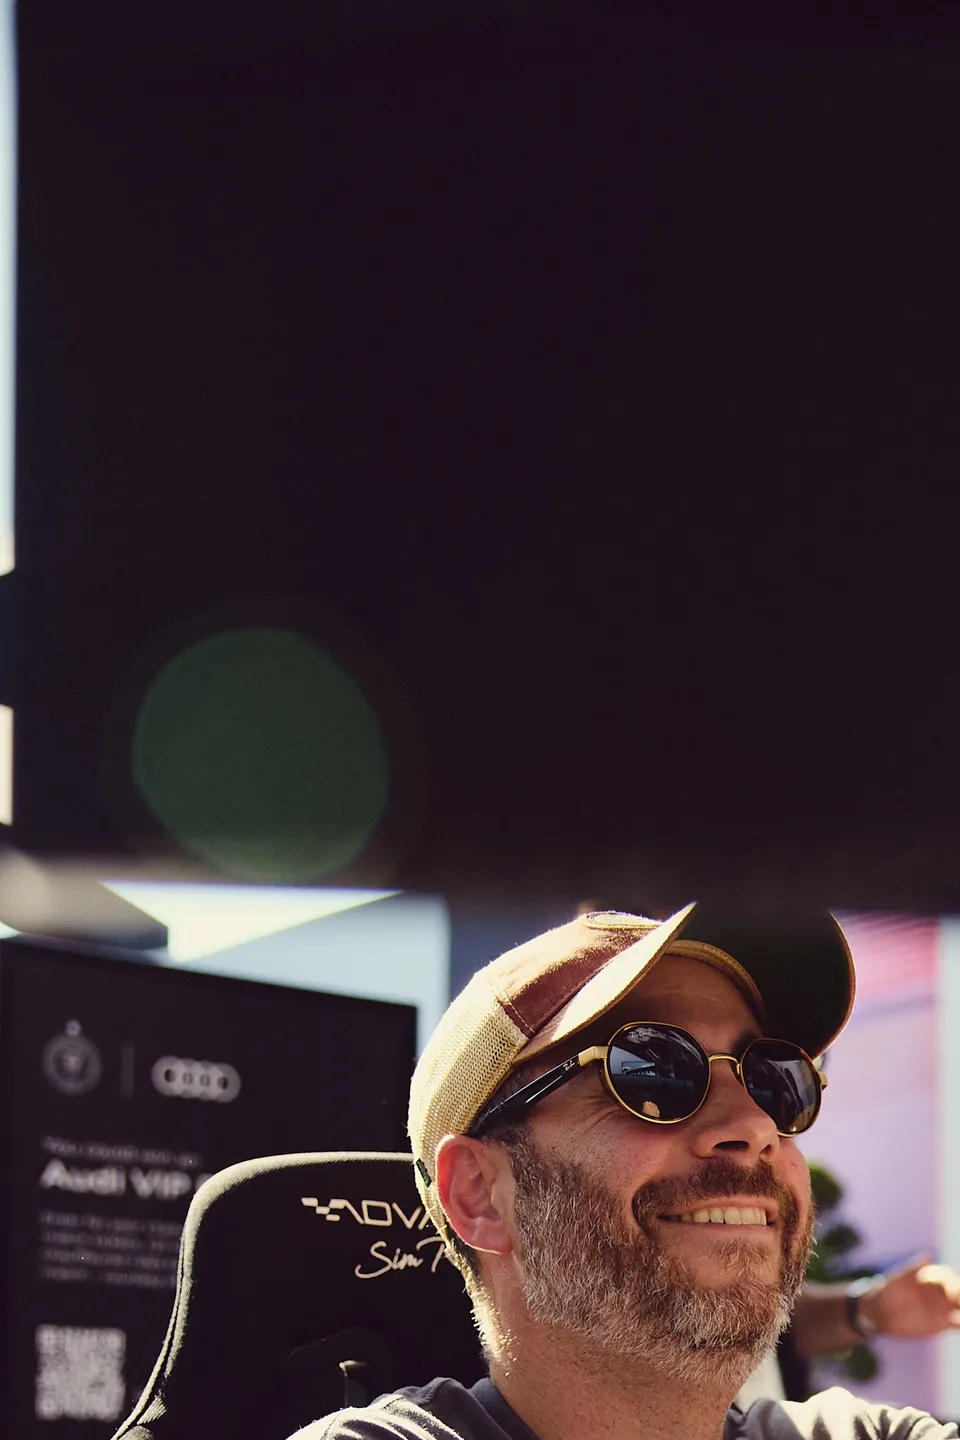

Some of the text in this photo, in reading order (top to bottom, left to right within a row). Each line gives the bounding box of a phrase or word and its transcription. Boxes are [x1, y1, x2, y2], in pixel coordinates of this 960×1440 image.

[41, 1159, 126, 1195] Audi
[130, 1166, 192, 1199] VIP
[355, 1241, 424, 1279] Sim
